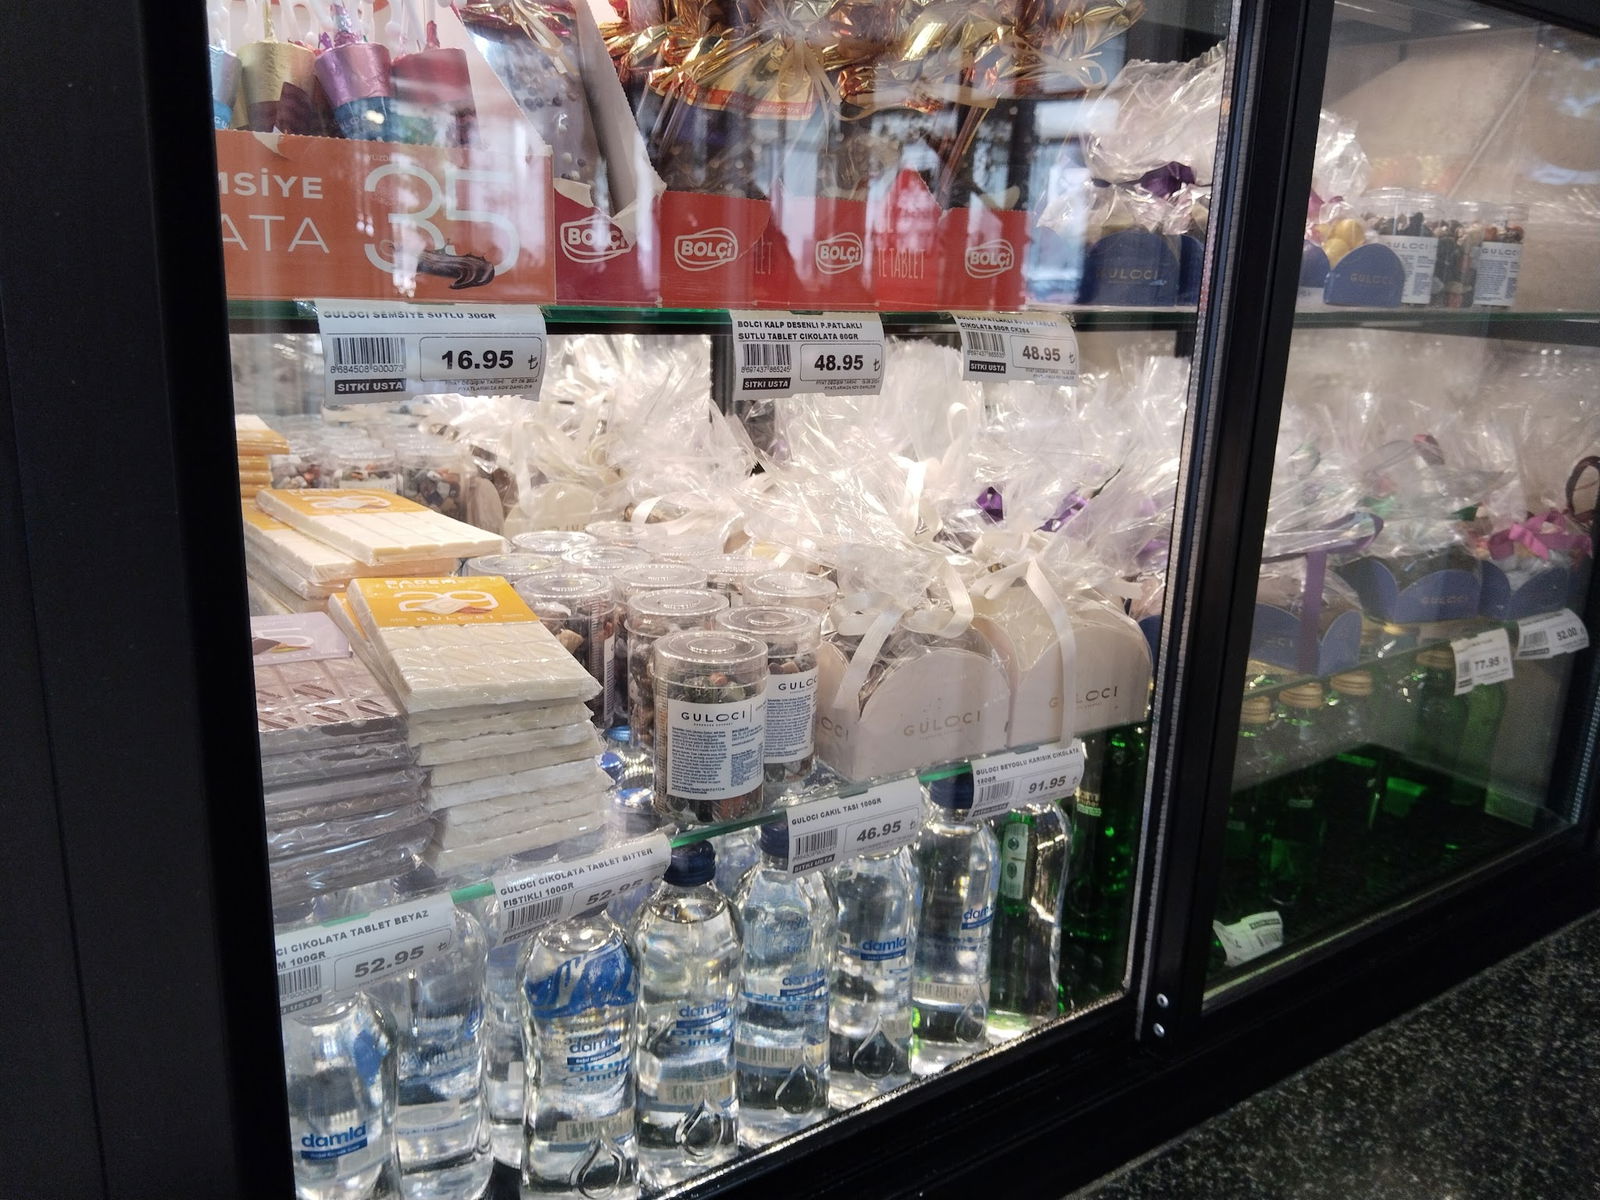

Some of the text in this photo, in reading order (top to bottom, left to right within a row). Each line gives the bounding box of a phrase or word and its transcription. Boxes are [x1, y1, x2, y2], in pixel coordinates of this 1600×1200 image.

[221, 212, 330, 254] ATA
[324, 310, 497, 320] GULOCI SEMSIYE SUTLU 30GR
[737, 320, 763, 328] BOLCI
[765, 321, 785, 329] KALP
[960, 322, 993, 330] CIKOLATA
[769, 333, 798, 341] TABLET
[800, 333, 838, 341] CIKOLATA
[441, 350, 515, 371] 16.95
[1022, 345, 1061, 362] 48.95
[814, 354, 864, 372] 48.95
[970, 363, 1005, 373] SITKI USTA
[337, 381, 403, 393] SITKI USTA
[744, 380, 788, 389] SITKI USTA
[681, 710, 746, 724] GULOCI
[976, 766, 1000, 776] GULOCI
[1000, 759, 1028, 771] BEYOGLU
[1028, 775, 1067, 795] 91.95
[791, 814, 820, 826] GULOCI
[820, 809, 842, 819] CAKIL
[843, 803, 859, 813] TASI
[856, 820, 902, 843] 46.95
[500, 847, 654, 897] GULOCI CIKOLATA TABLET BITTER
[502, 882, 575, 909] FISTIKLI 100GR
[290, 932, 348, 953] CIKOLATA
[350, 919, 392, 937] TABLET
[394, 909, 430, 926] BEYAZ
[861, 936, 908, 952] damla
[291, 950, 327, 967] 100GR
[354, 945, 425, 979] 52.95
[301, 1122, 368, 1149] damla
